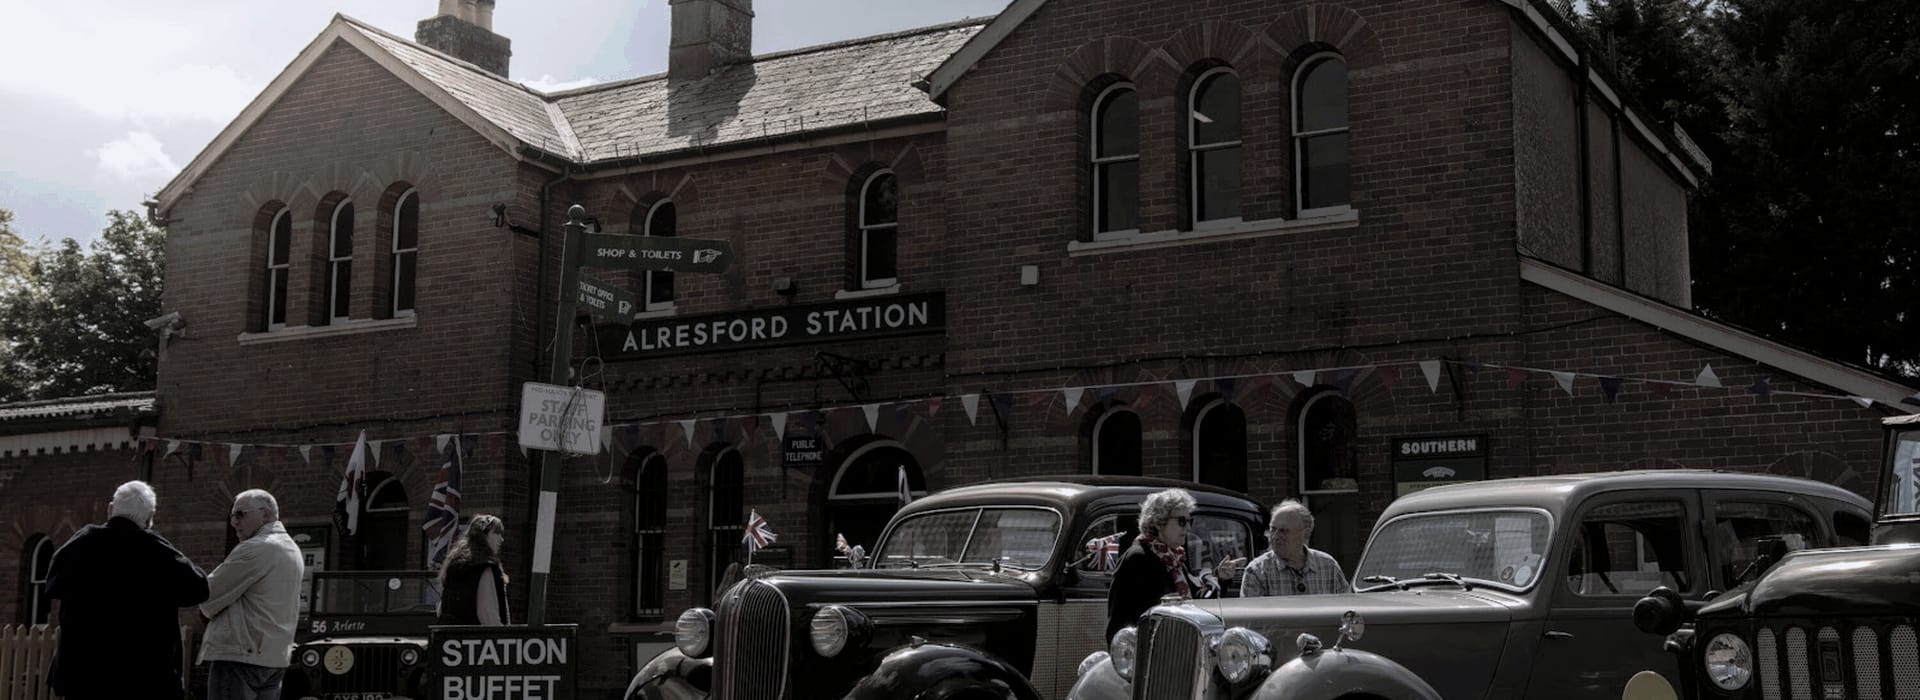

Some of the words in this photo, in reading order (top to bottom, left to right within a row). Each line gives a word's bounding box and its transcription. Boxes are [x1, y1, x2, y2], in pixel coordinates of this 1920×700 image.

[597, 248, 625, 258] SHOP
[628, 250, 637, 258] &
[641, 249, 682, 260] TOILETS
[586, 294, 605, 309] TOILETS
[622, 315, 788, 352] ALRESFORD
[806, 301, 928, 336] STATION
[540, 428, 582, 445] OLY
[791, 439, 816, 449] PUBLIC
[1401, 439, 1476, 455] SOUTHERN
[785, 450, 823, 462] TELEPHONE
[311, 620, 327, 633] 56
[332, 620, 366, 632] Arlette
[441, 637, 568, 667] STATION
[443, 675, 561, 700] BUFFET
